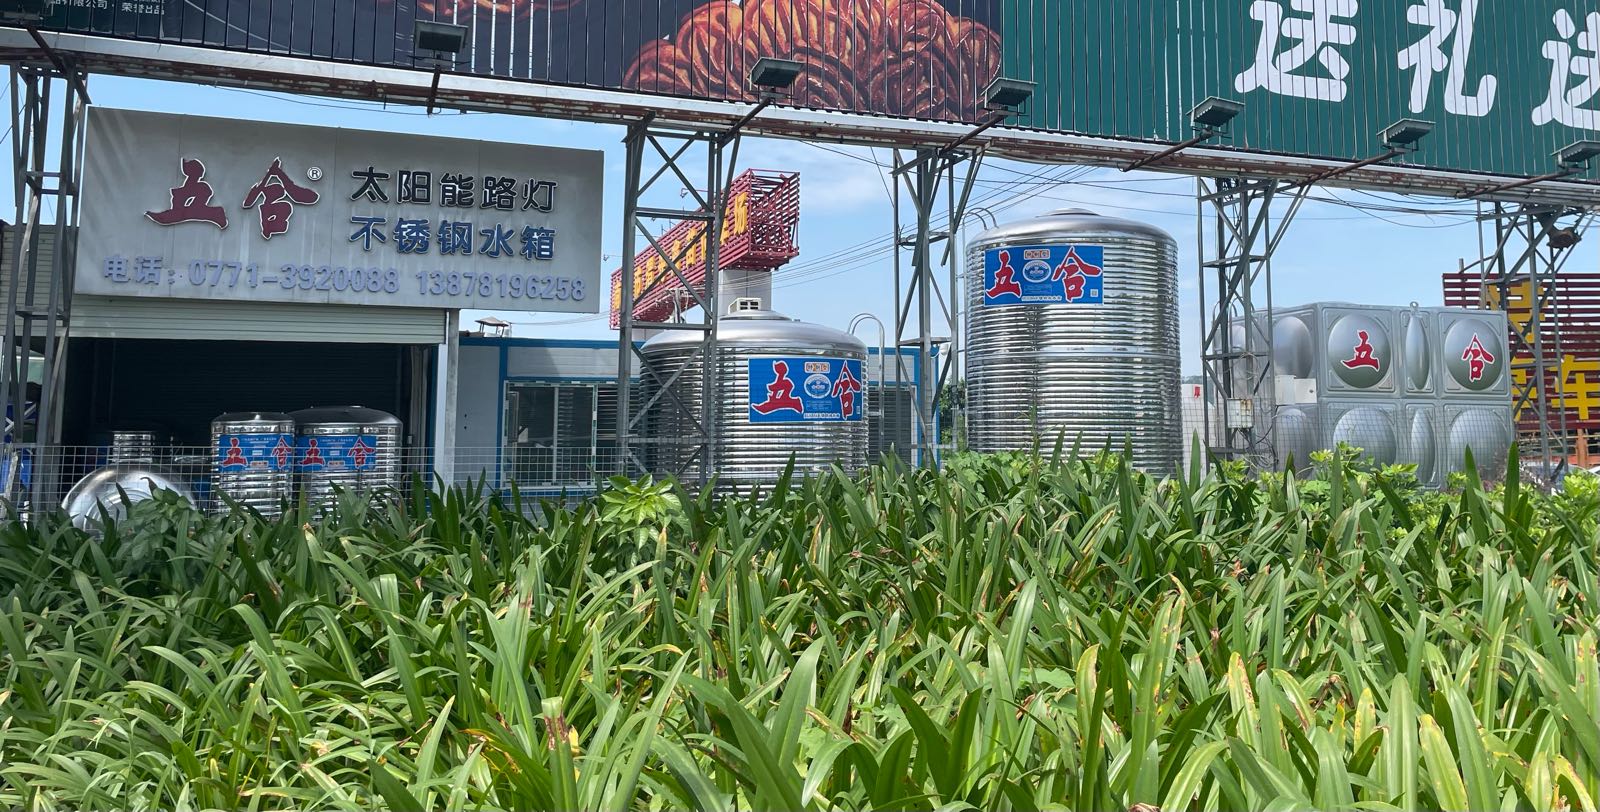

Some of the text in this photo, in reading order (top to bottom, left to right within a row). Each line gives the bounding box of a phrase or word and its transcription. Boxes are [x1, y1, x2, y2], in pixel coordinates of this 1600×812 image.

[350, 166, 558, 212] 太阳能路灯
[349, 215, 556, 260] 不锈钢水箱
[188, 258, 400, 293] 0771-3920088
[416, 270, 586, 301] 13878196258
